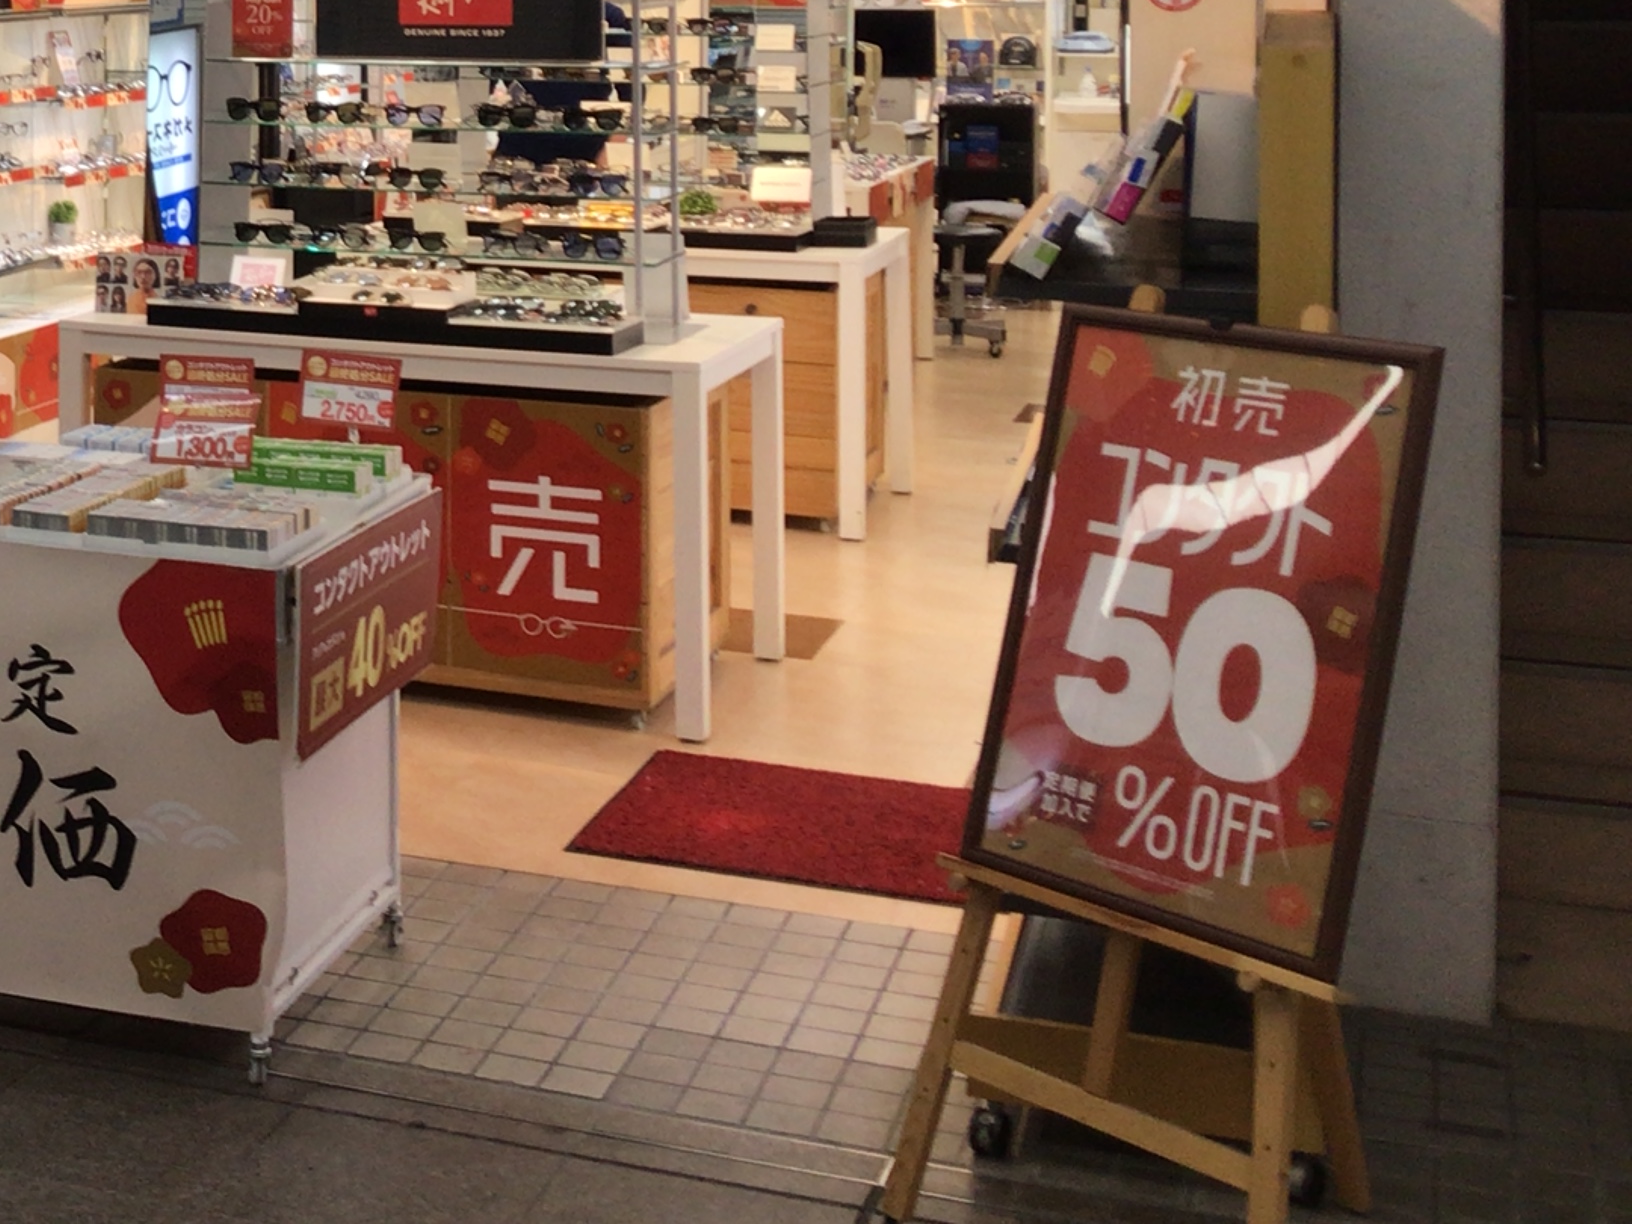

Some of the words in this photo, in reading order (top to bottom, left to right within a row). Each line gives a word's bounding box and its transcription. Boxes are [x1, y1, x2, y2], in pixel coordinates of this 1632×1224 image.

[1171, 365, 1291, 437] 初売
[488, 475, 603, 604] 売
[1054, 553, 1318, 783] 50
[1115, 765, 1280, 887] %OFF
